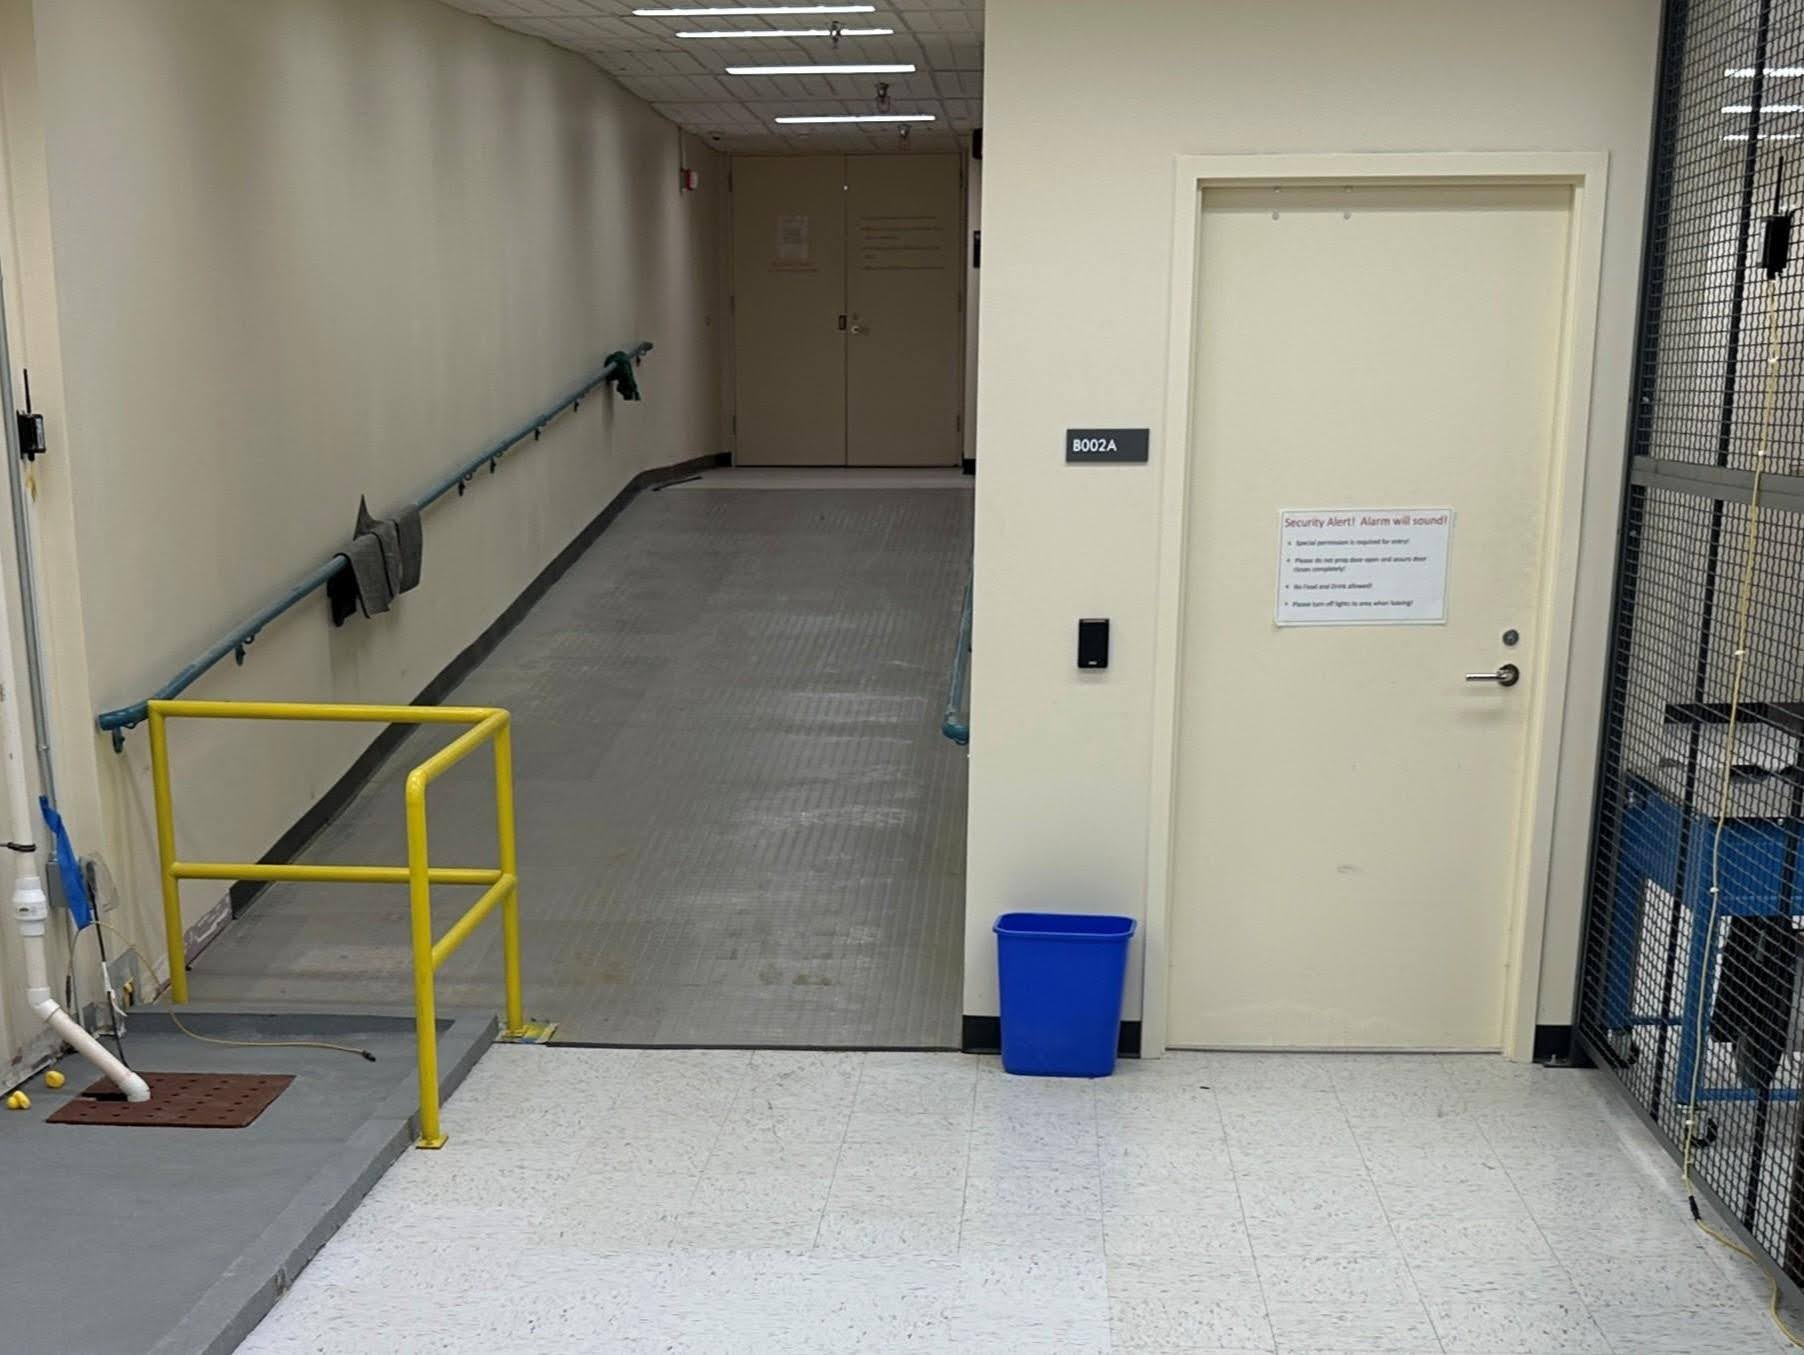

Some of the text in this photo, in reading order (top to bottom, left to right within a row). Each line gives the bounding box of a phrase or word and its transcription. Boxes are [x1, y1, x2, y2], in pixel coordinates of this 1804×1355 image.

[1073, 439, 1117, 452] B002A
[1285, 514, 1448, 528] Security Alert! Alarm will sound!
[1317, 539, 1349, 547] permission
[1356, 538, 1380, 546] required
[1334, 557, 1349, 565] prop
[1335, 600, 1351, 608] lights
